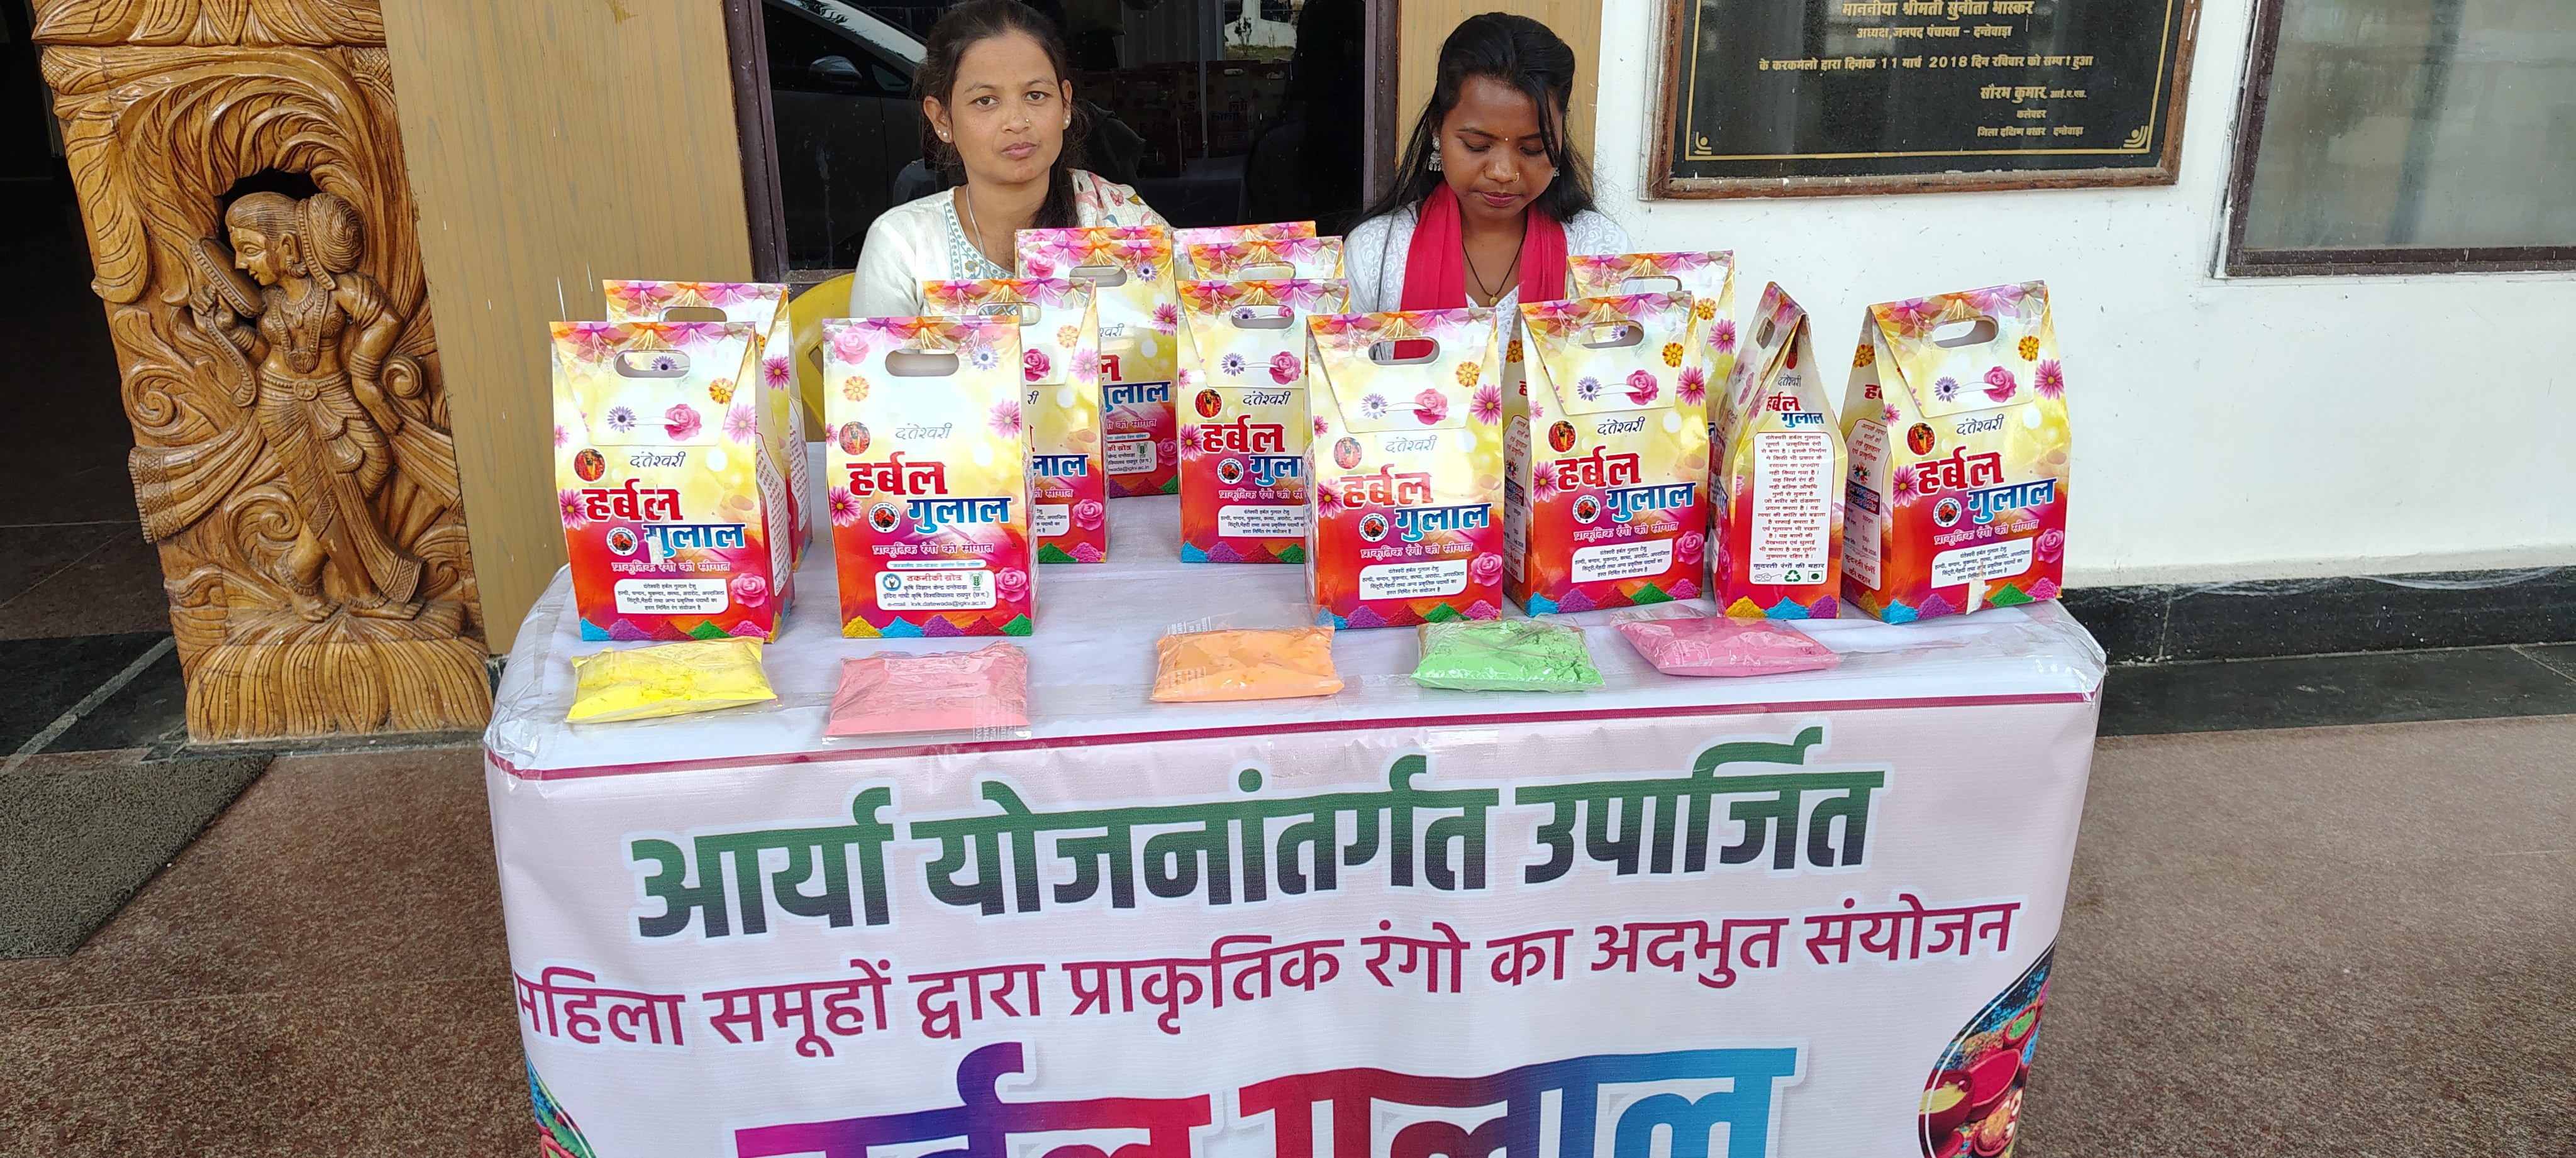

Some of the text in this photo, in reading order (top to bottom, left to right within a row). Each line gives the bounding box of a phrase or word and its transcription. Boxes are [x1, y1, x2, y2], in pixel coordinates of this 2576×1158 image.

[1992, 1, 2035, 15] भास्कर
[1927, 23, 1960, 38] पंचायत
[1759, 58, 1769, 70] के
[1821, 59, 1841, 71] द्वारा
[1845, 57, 1876, 70] दिनांक
[1929, 56, 1968, 67] 2018
[2027, 53, 2041, 66] को
[1980, 83, 2012, 99] सौरभ
[2012, 86, 2046, 103] कुमार
[1778, 373, 1802, 387] दंतेश्वरी
[1242, 390, 1291, 406] दंतेश्वरी
[1766, 392, 1801, 412] हर्बल
[1597, 416, 1646, 436] दंतेश्वरी
[1781, 412, 1824, 428] गुलाल
[1957, 413, 2004, 435] दंतेश्वरी
[895, 422, 953, 441] दंतेश्वरी
[1201, 415, 1285, 455] हर्बल
[1385, 434, 1437, 453] दंतेश्वरी
[629, 450, 686, 469] दंतेश्वरी
[1554, 445, 1641, 492] हर्बल
[846, 451, 948, 497] हर्बल
[1248, 455, 1304, 486] गुला
[1915, 445, 2004, 497] हर्बल
[1219, 488, 1257, 502] प्राकृतिक
[1277, 488, 1291, 499] की
[1340, 463, 1434, 509] हर्बल
[581, 479, 684, 522] हर्बल
[1606, 482, 1697, 522] गुलाल
[1968, 478, 2057, 523] गुलाल
[906, 497, 1011, 534] गुलाल
[1394, 502, 1493, 542] गुलाल
[642, 522, 746, 558] गुलाल
[1574, 527, 1614, 543] प्राकृतिक
[1616, 524, 1632, 537] रंगो
[1635, 522, 1648, 534] की
[1934, 519, 2039, 546] प्राकृतिक रंगो की सौगात
[872, 541, 994, 558] प्राकृतिक रंगो की सौगात
[1360, 541, 1473, 561] प्राकृतिक रंगो की सौगात
[611, 560, 656, 575] प्राकृतिक
[679, 561, 695, 572] की
[697, 560, 730, 572] सौगात
[906, 573, 942, 582] तकनीकी
[631, 726, 1885, 939] आर्या योजनांतर्गत उपार्जित
[513, 893, 2021, 1058] महिला समूहों द्वारा प्राकृतिक रंगो का अदभुत संयोजन
